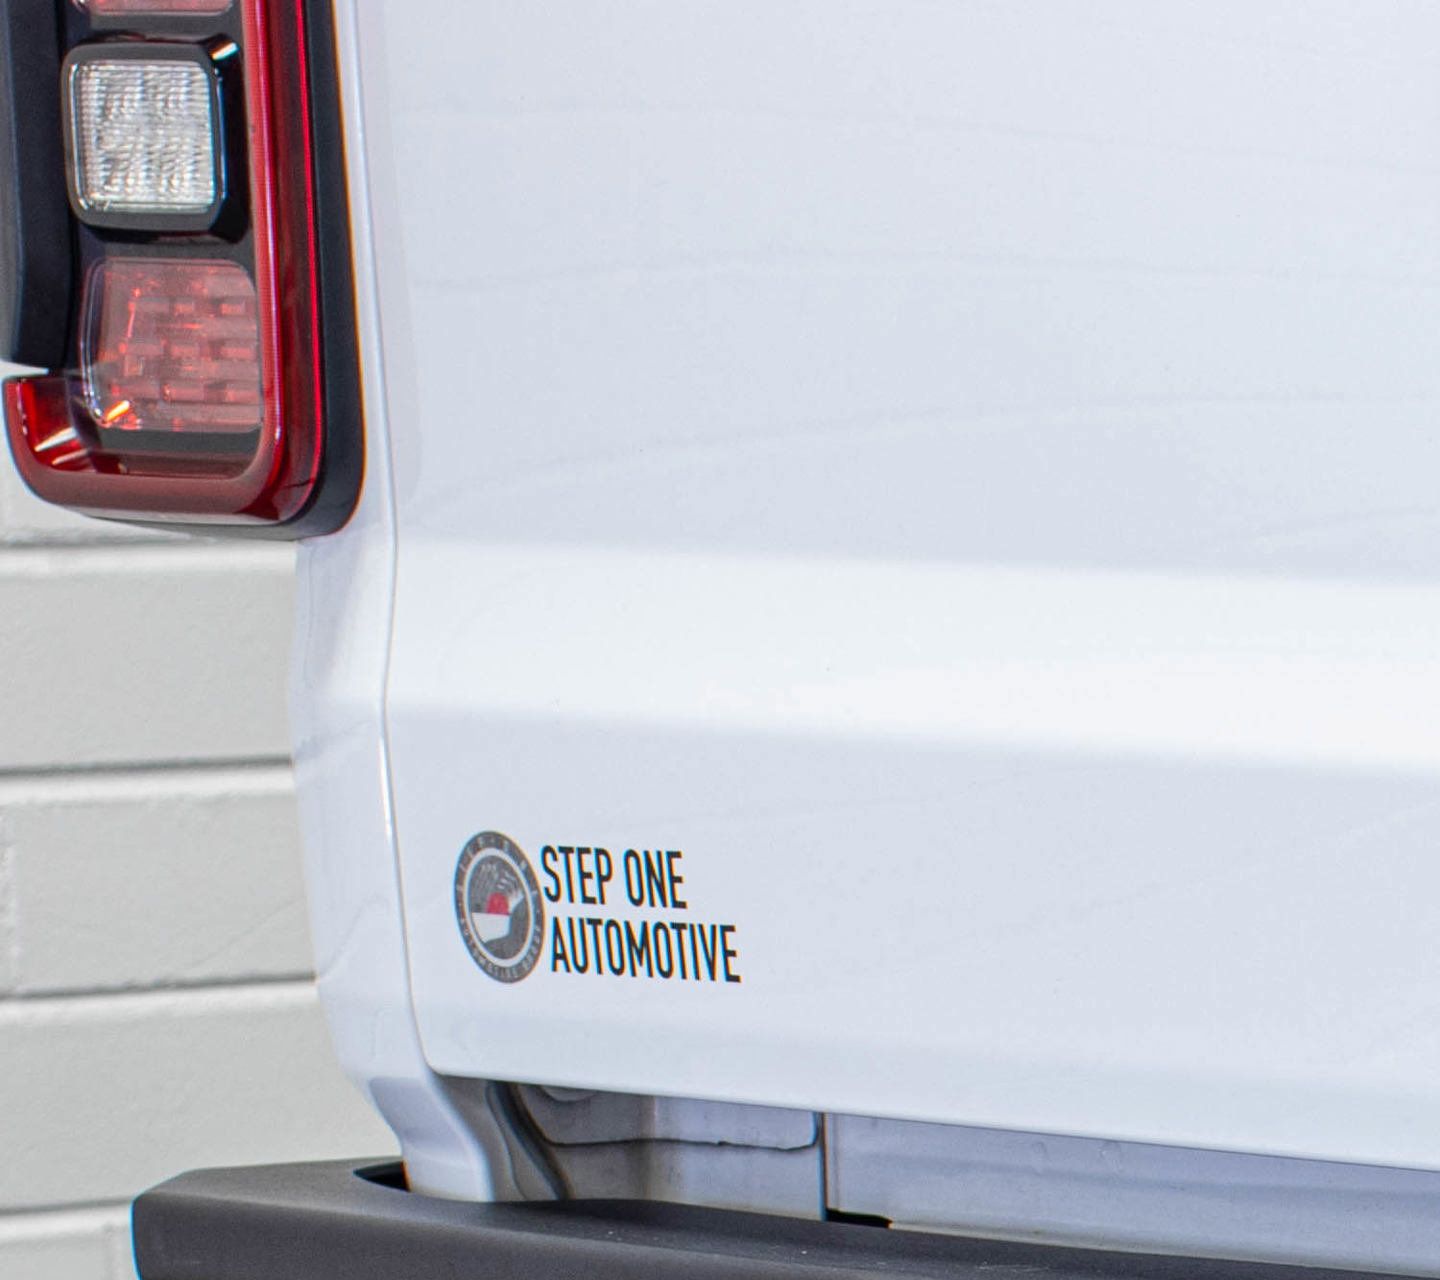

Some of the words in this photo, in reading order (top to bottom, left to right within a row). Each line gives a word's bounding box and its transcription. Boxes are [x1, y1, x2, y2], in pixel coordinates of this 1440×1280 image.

[541, 845, 614, 905] STEP
[624, 848, 688, 909] ONE
[551, 916, 742, 983] AUTOMOTIVE
